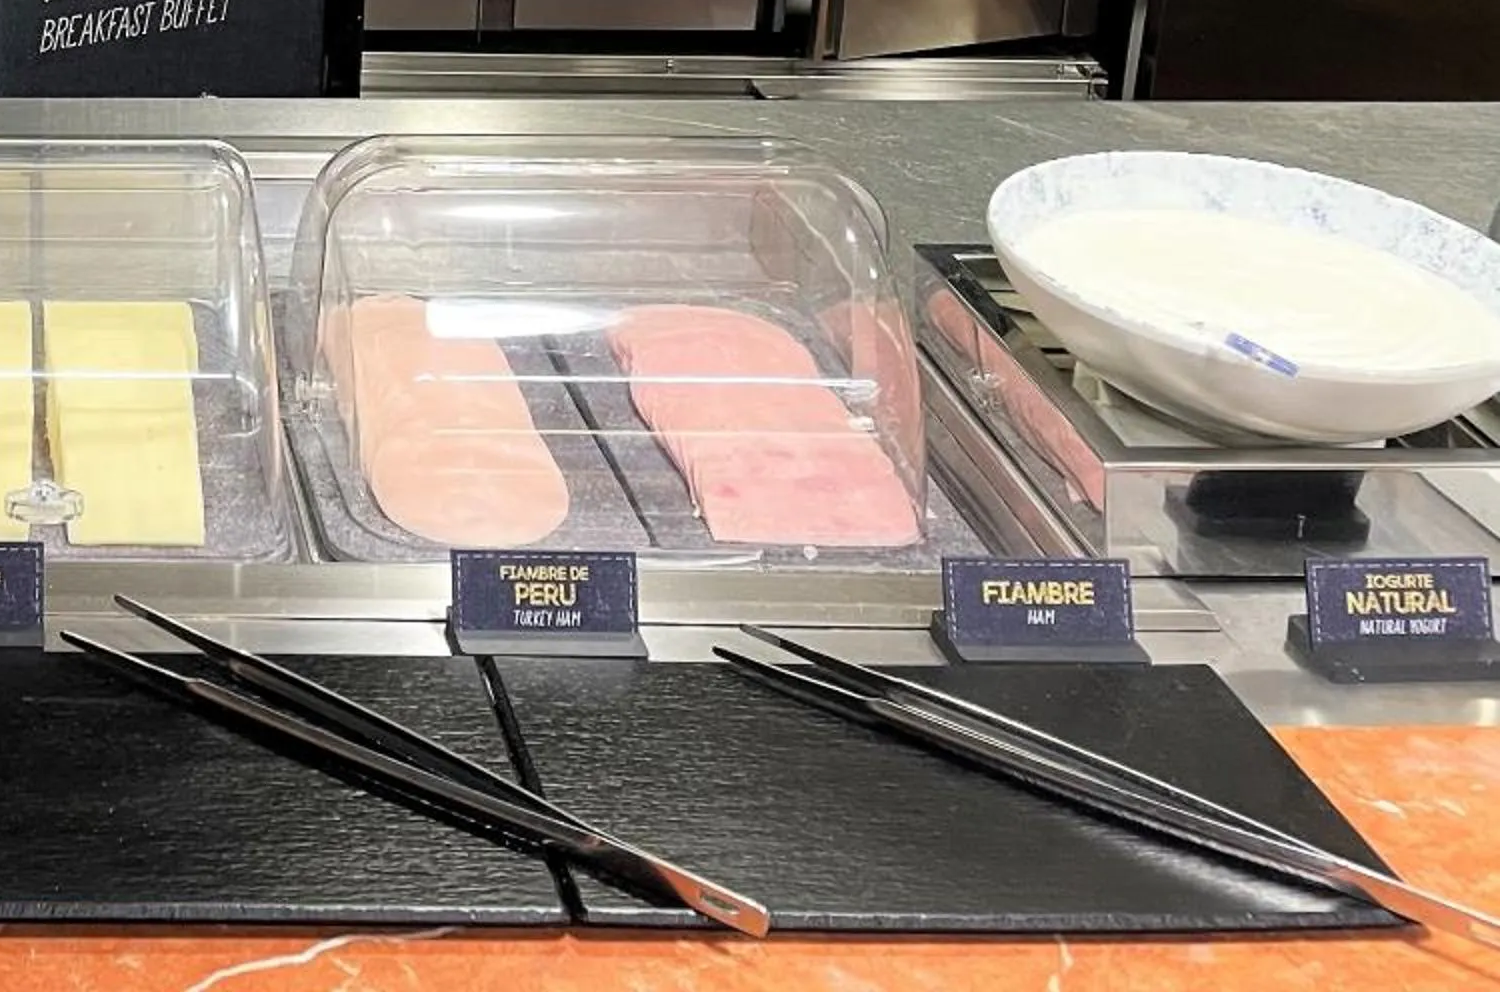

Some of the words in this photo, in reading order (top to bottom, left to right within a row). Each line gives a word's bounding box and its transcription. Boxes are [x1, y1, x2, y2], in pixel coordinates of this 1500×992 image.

[39, 1, 157, 53] BREAKFAST
[500, 565, 566, 581] FIAMBRE
[569, 567, 589, 581] DE
[1364, 573, 1434, 589] IOGURTE
[514, 583, 577, 607] PERU
[981, 581, 1095, 605] FIAMBRE
[1346, 590, 1457, 615] NATURAL
[513, 609, 553, 626] TURKEY
[555, 610, 581, 627] HAM
[1027, 609, 1055, 625] HAM
[1359, 618, 1406, 635] NATURAL
[1409, 618, 1447, 635] YOGURT
